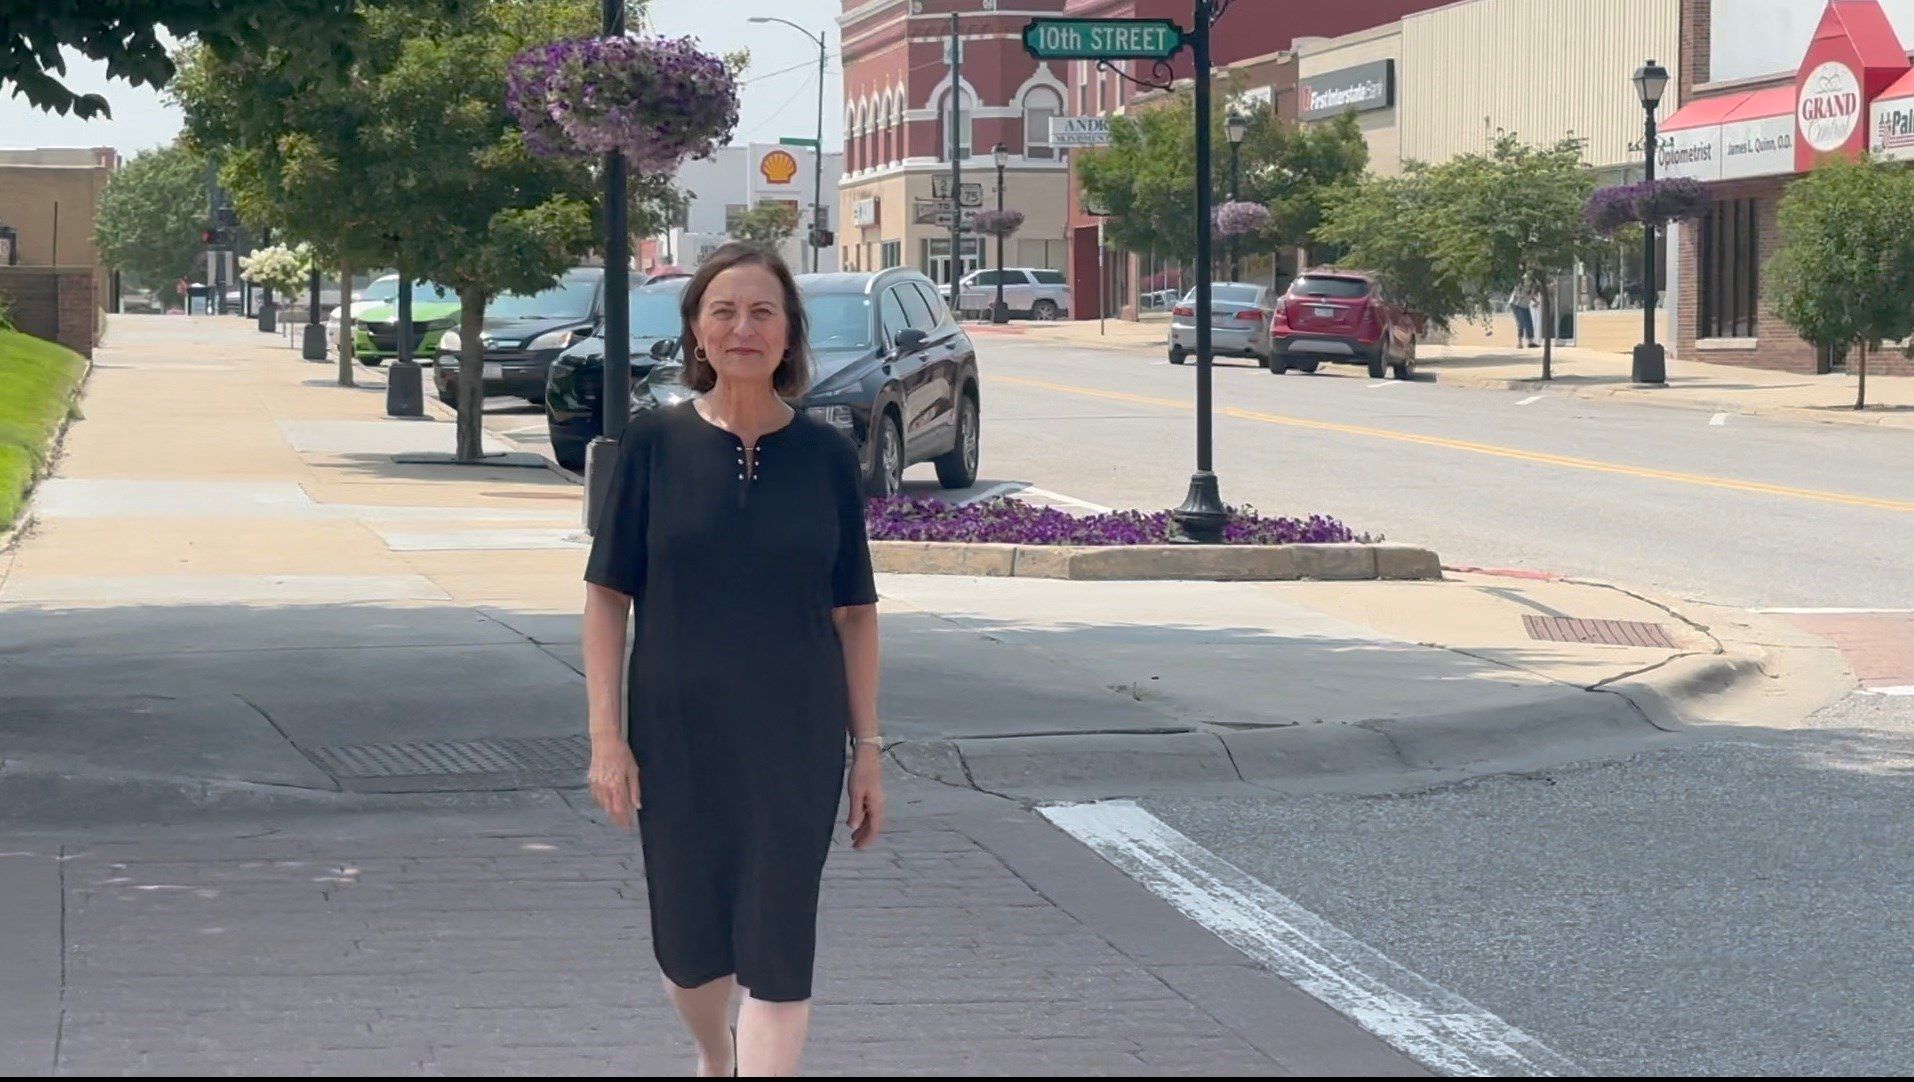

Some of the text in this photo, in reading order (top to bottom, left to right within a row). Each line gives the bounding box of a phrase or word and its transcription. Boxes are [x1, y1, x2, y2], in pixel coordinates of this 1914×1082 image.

[1038, 27, 1167, 50] 10th STREET
[1802, 93, 1857, 120] GRAND
[1064, 120, 1109, 131] ANDR
[1892, 109, 1914, 136] Pal
[1657, 141, 1711, 171] Optometrist
[1727, 142, 1747, 155] James
[964, 191, 979, 202] 75
